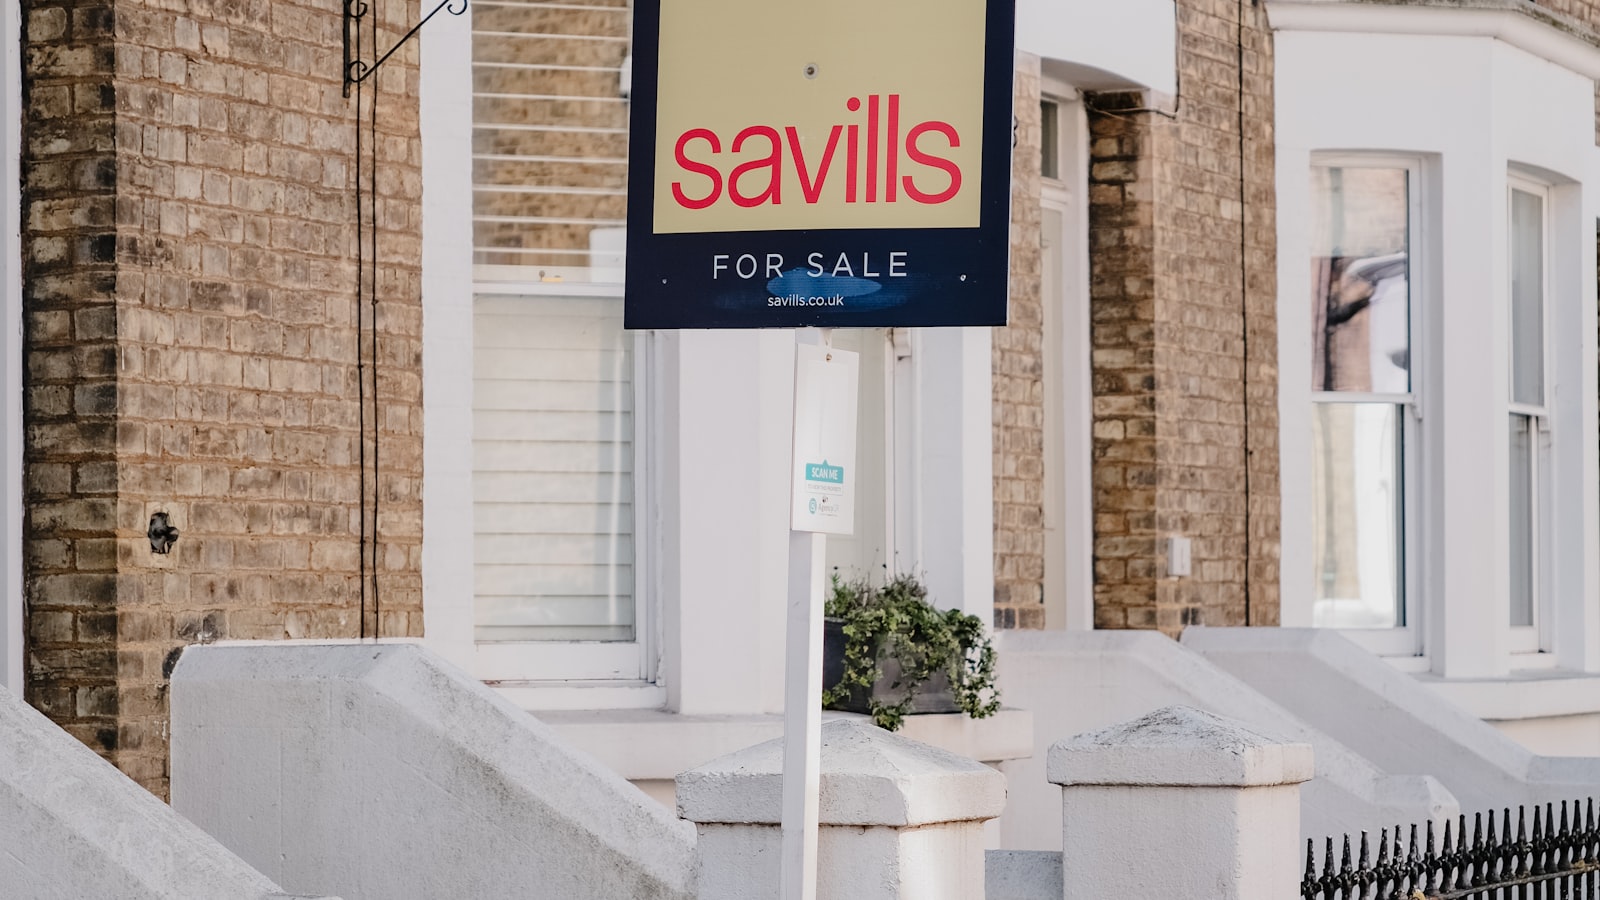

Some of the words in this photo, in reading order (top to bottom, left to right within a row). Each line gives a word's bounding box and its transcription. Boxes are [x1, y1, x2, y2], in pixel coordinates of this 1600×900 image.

[671, 94, 962, 209] savills
[713, 253, 784, 279] FOR
[807, 252, 908, 277] SALE
[767, 294, 844, 307] savills.co.uk
[811, 466, 828, 480] SCAN
[829, 469, 839, 481] ME
